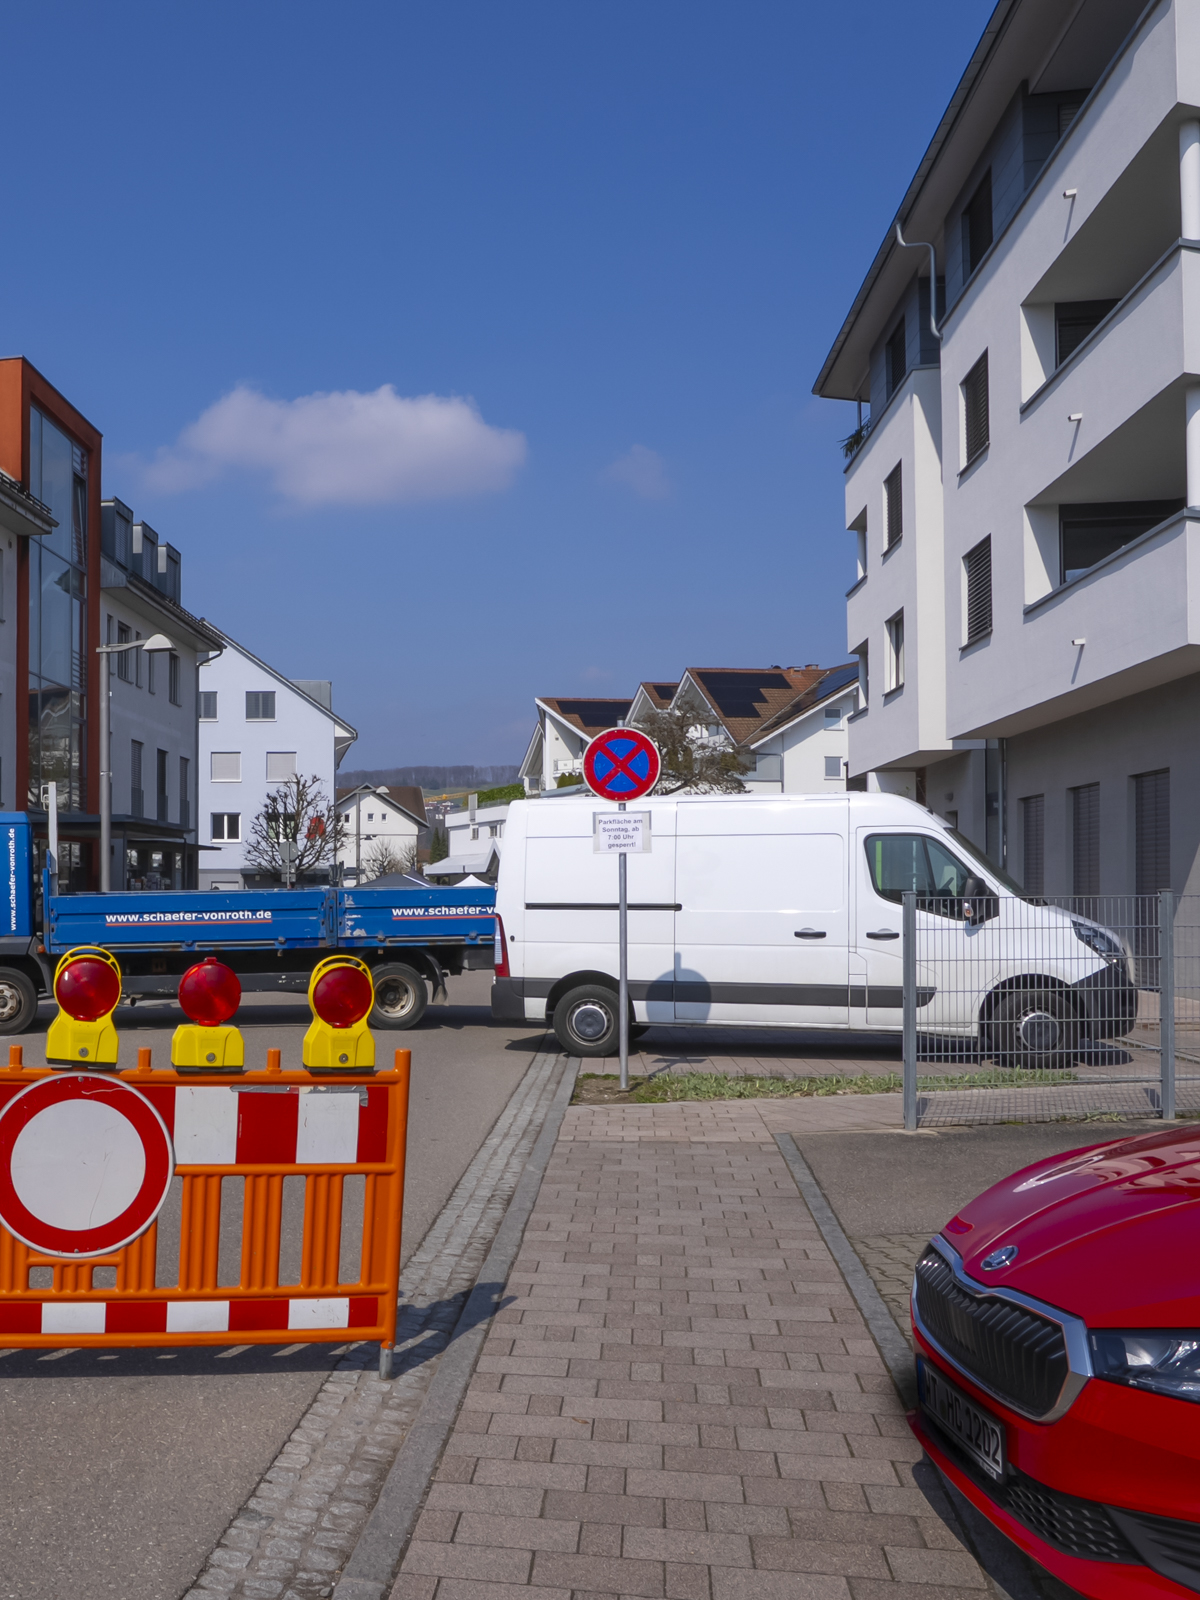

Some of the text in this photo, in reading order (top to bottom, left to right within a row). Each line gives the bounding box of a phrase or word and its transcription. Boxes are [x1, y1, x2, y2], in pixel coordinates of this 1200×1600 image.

[8, 828, 16, 931] www.schaefer-vonroth.de
[105, 910, 272, 923] www.schaefer-vonroth.de
[946, 1387, 963, 1433] HC
[965, 1405, 1001, 1467] 1202
